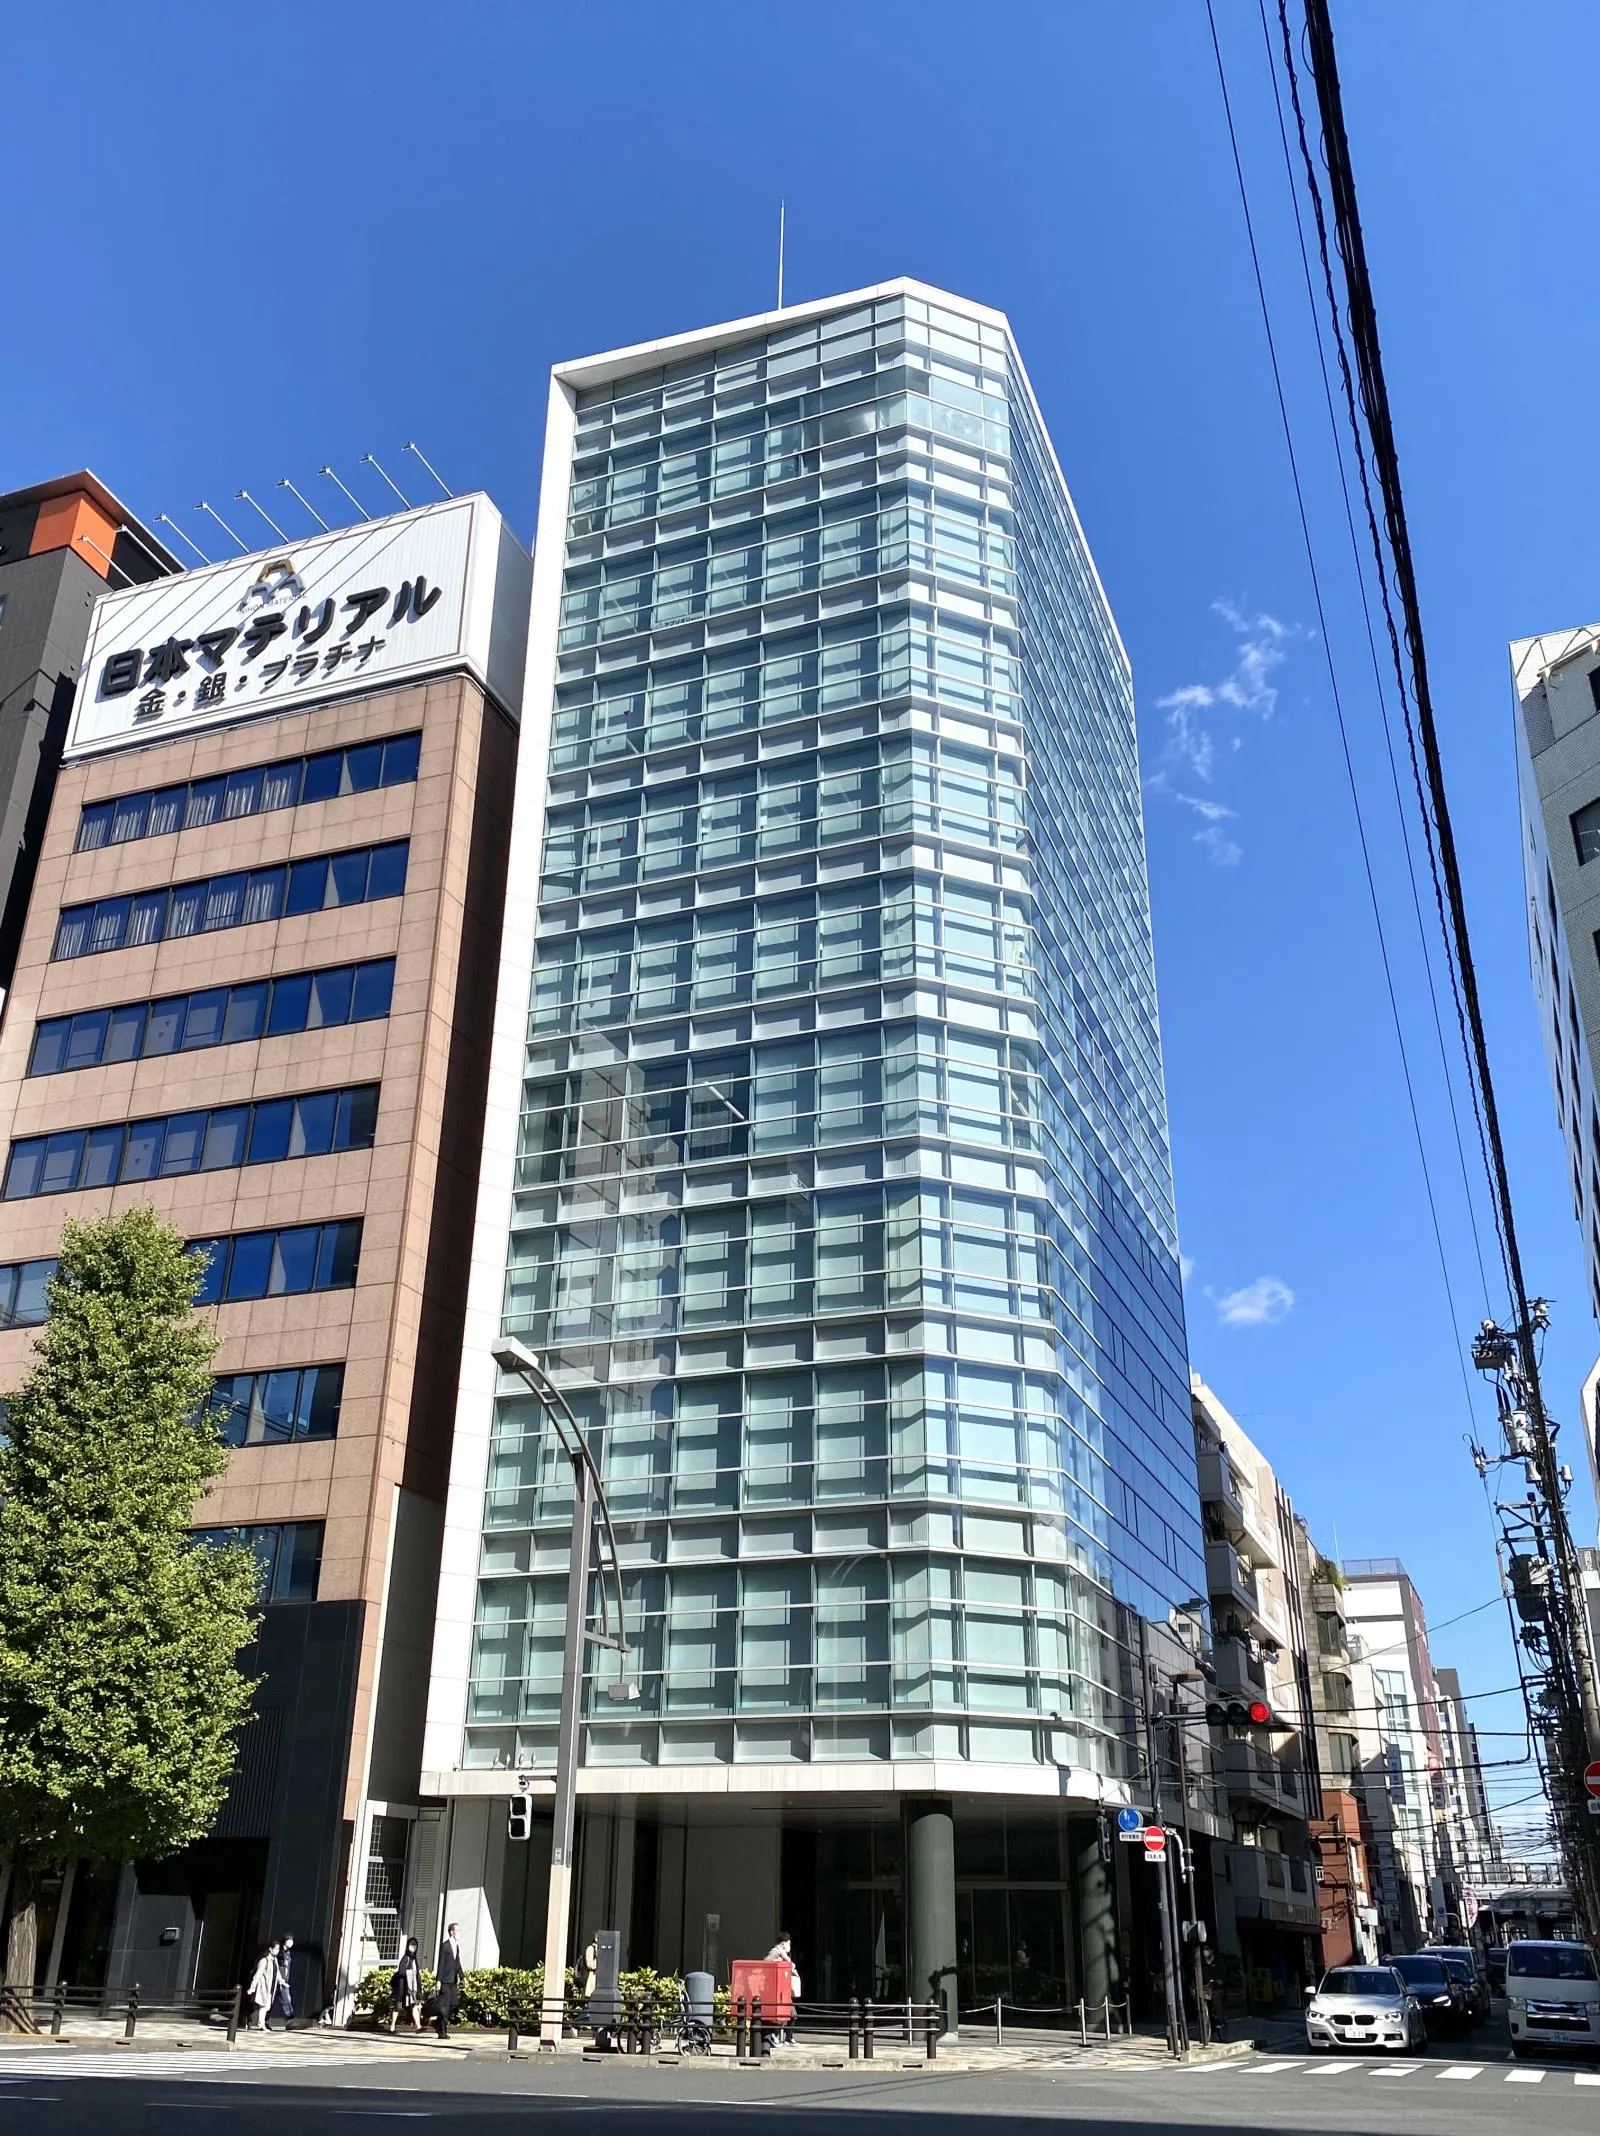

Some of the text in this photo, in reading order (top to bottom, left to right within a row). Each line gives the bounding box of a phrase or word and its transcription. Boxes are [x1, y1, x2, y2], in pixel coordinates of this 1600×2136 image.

[101, 575, 442, 696] 日本マテリアル
[138, 635, 386, 717] 金・銀・プラチナ
